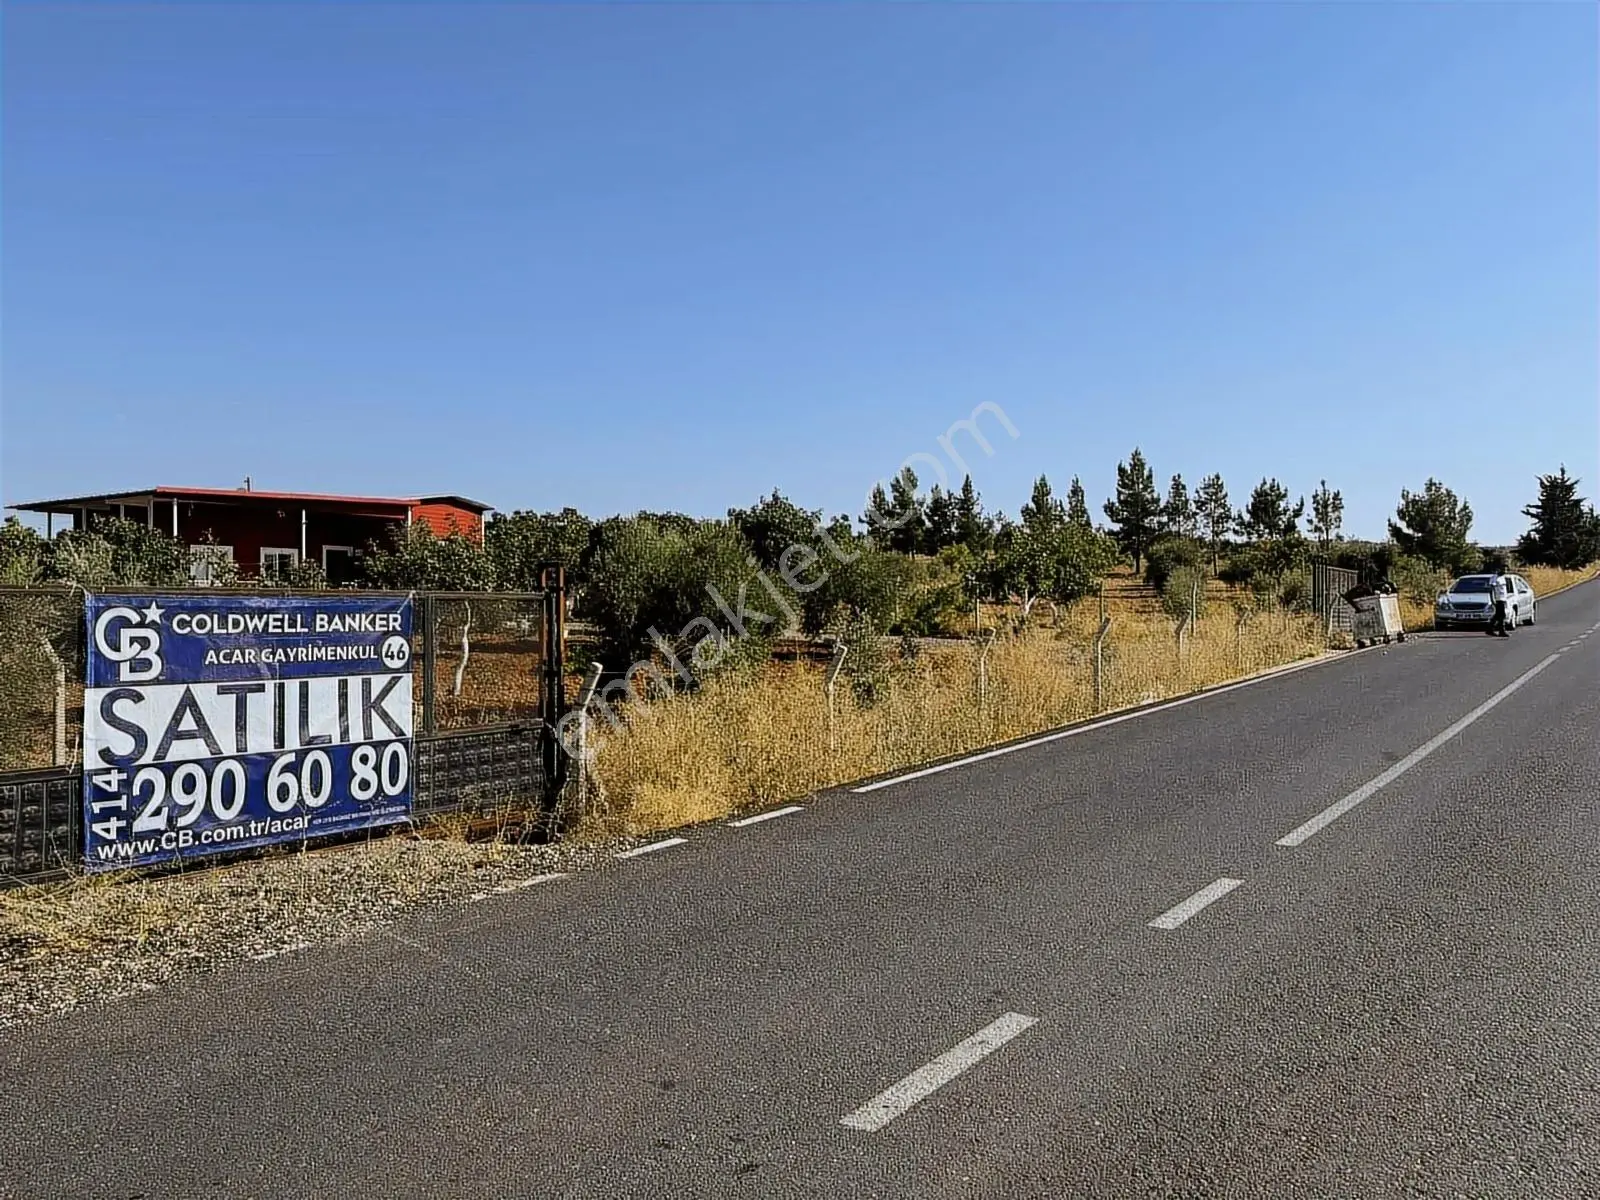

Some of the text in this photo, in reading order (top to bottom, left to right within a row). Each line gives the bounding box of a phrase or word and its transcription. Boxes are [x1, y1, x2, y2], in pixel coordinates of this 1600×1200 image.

[95, 606, 162, 682] CB
[171, 613, 402, 635] COLDWELL BANKER
[384, 643, 407, 662] 46
[204, 644, 378, 665] ACAR GAYRİMENKUL
[98, 675, 408, 766] SATILIK
[91, 769, 127, 840] 414
[132, 741, 409, 834] 290 60 80
[97, 814, 312, 860] www.CB.com.tr/acar
